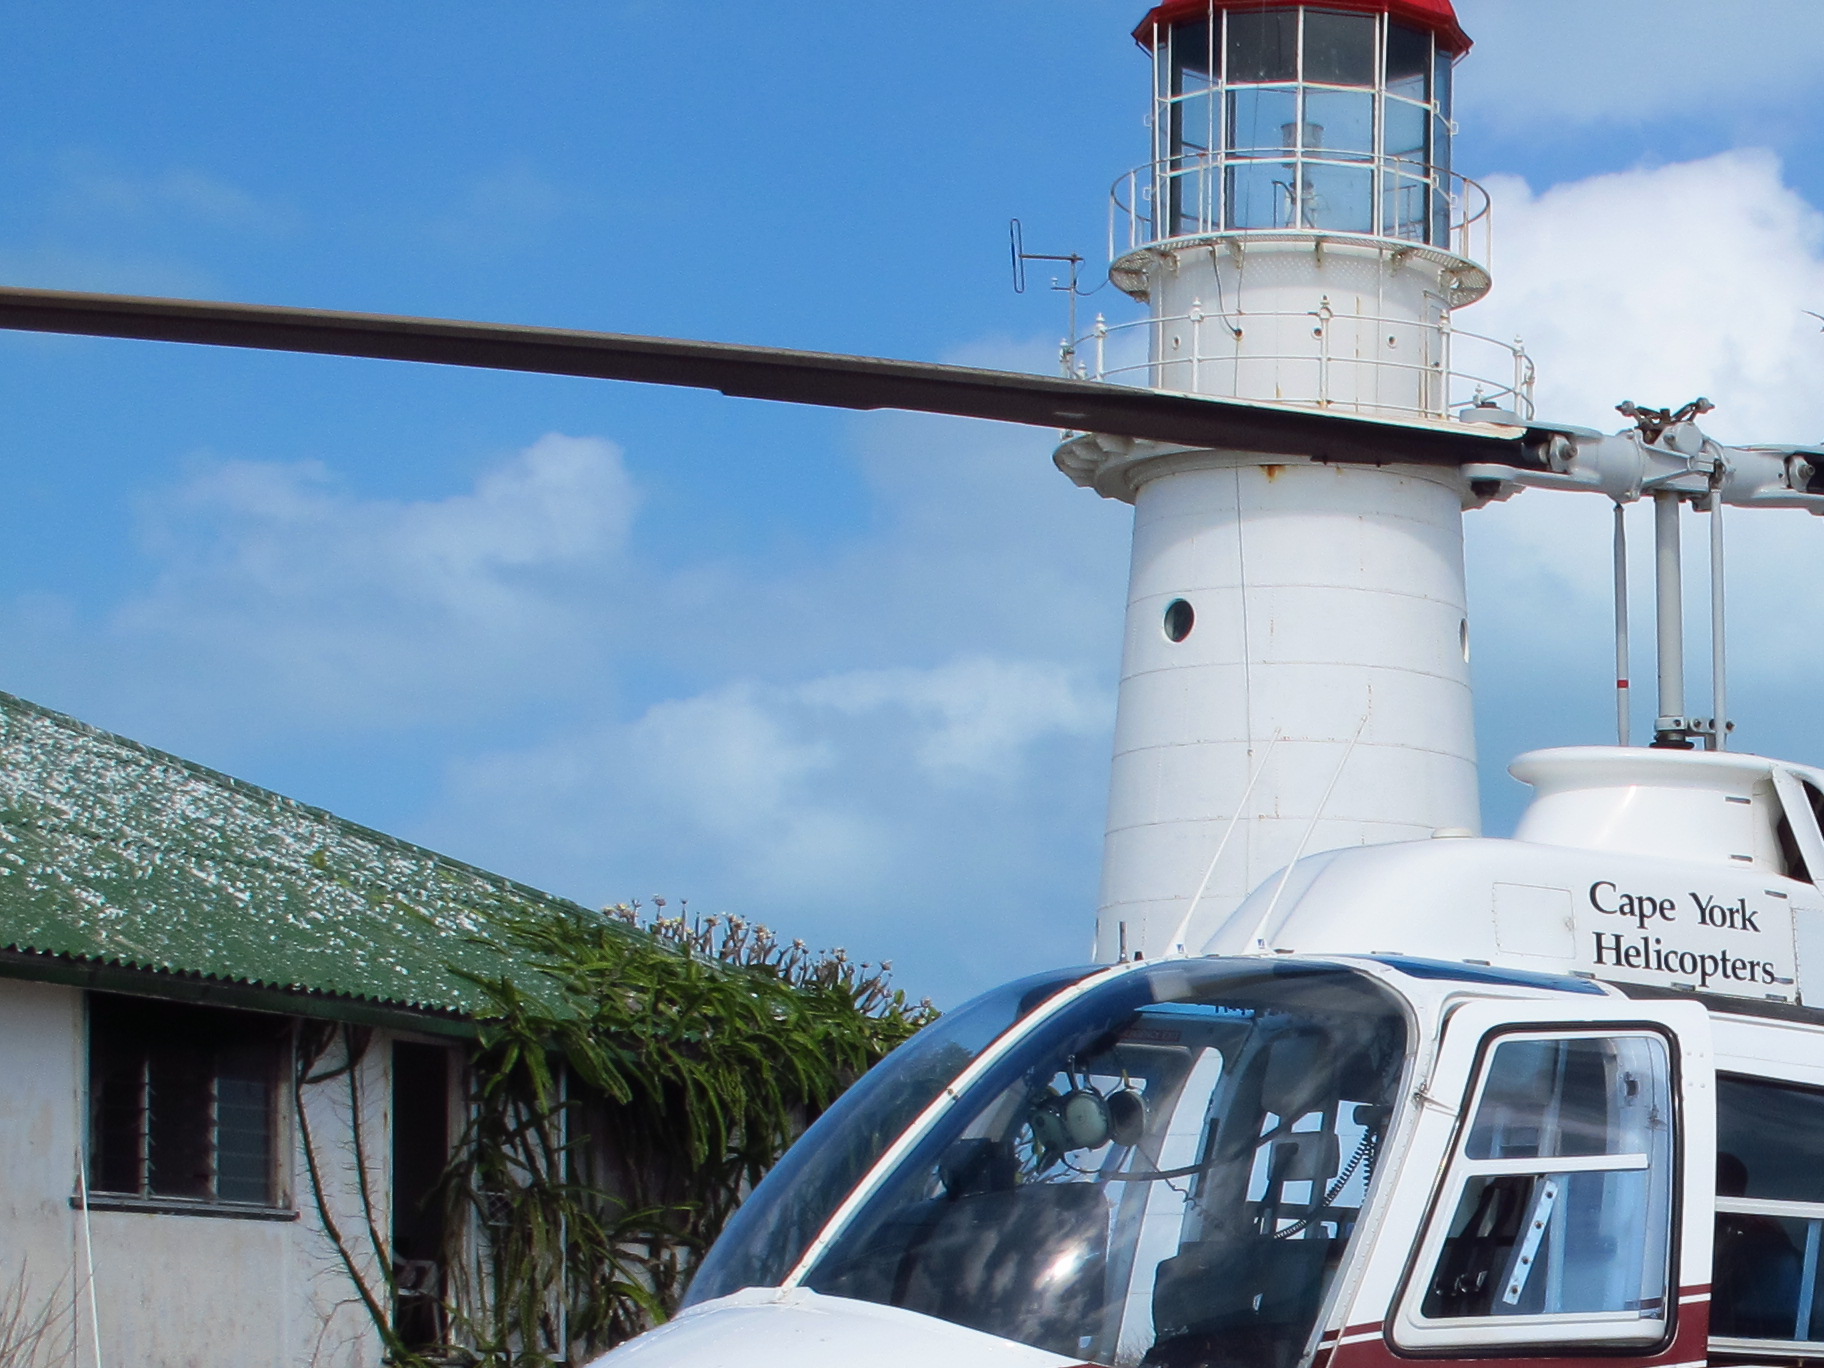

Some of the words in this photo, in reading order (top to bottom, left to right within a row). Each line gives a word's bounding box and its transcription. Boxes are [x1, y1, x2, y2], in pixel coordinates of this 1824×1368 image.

[1589, 880, 1676, 930] Cape
[1688, 891, 1762, 933] York
[1591, 930, 1776, 988] Helicopters
